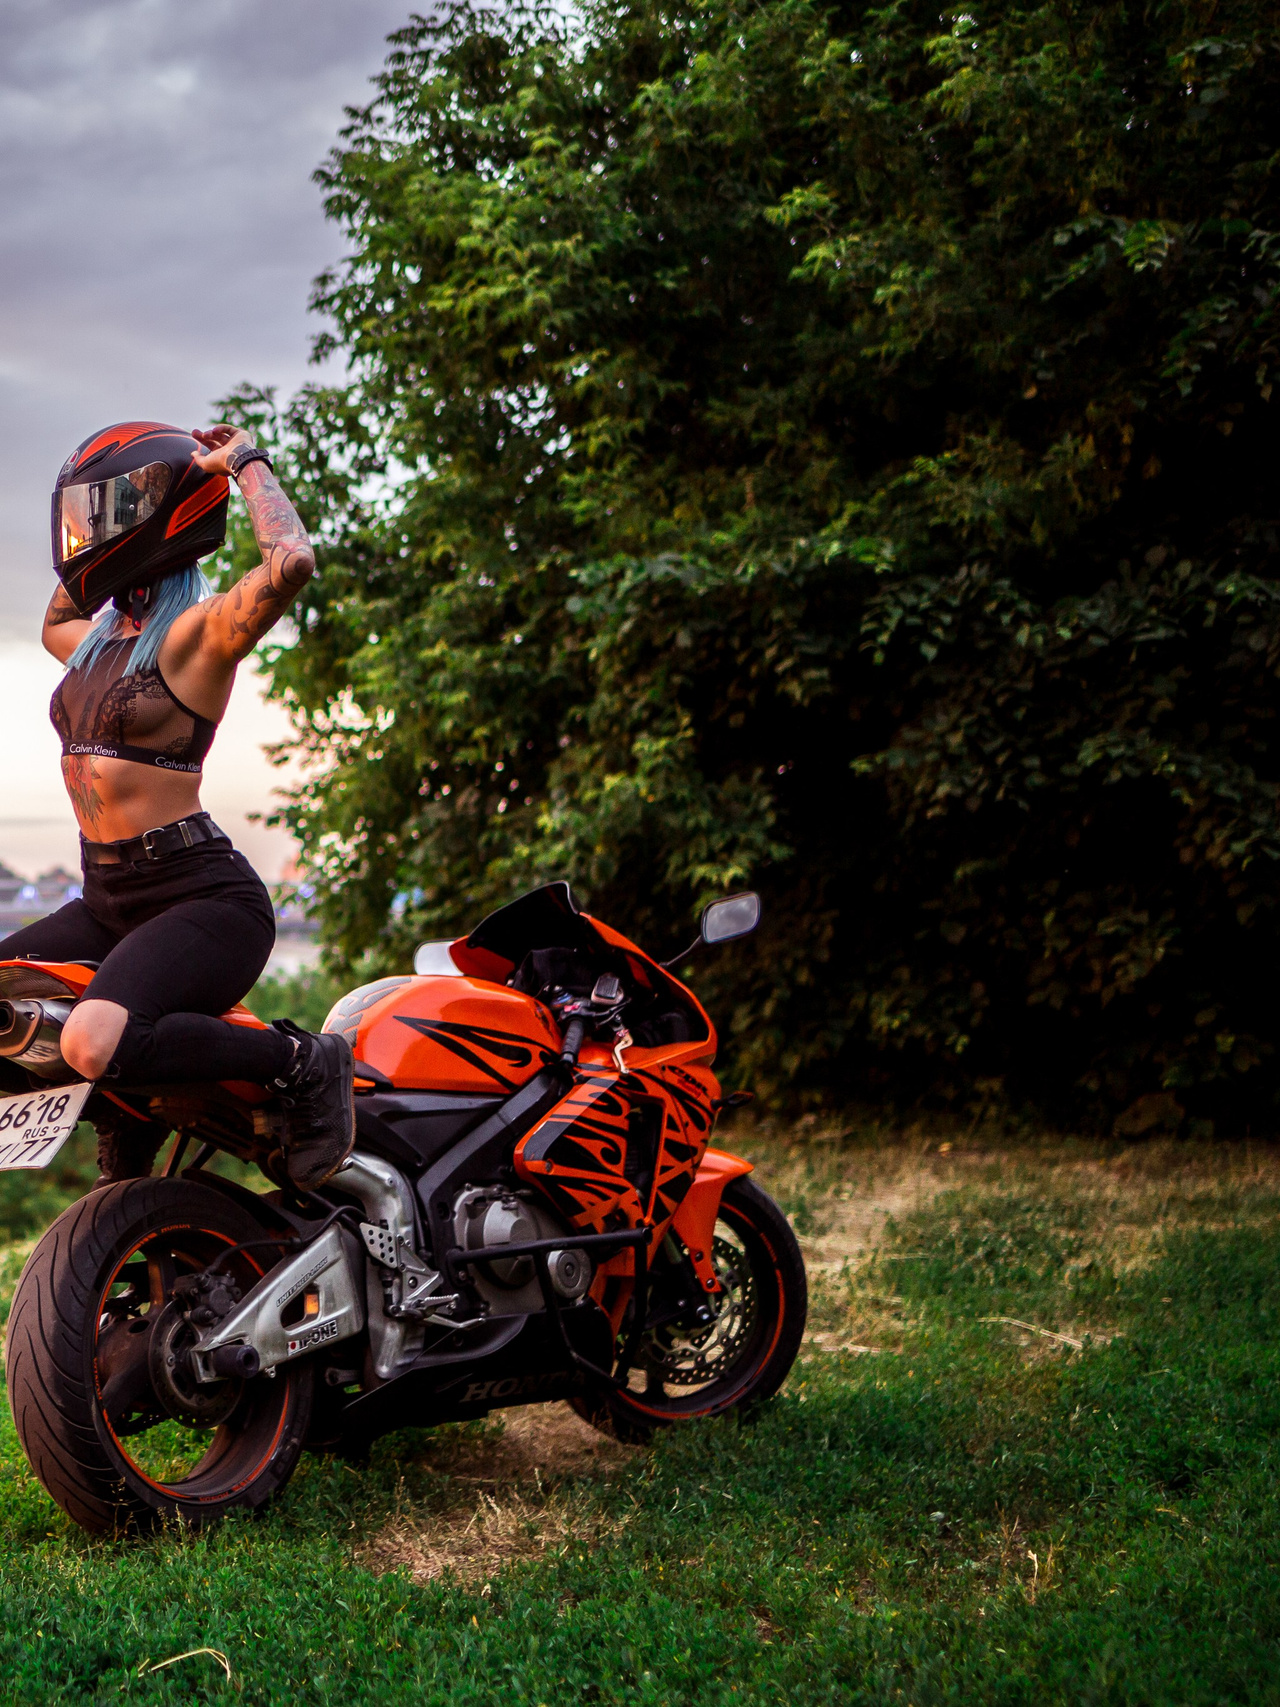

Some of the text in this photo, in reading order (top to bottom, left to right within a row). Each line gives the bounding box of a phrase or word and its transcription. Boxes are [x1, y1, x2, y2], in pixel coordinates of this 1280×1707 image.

[69, 743, 118, 757] Calvin Klein
[154, 756, 187, 771] Calvin
[22, 1126, 49, 1140] RUS
[10, 1136, 58, 1164] 77
